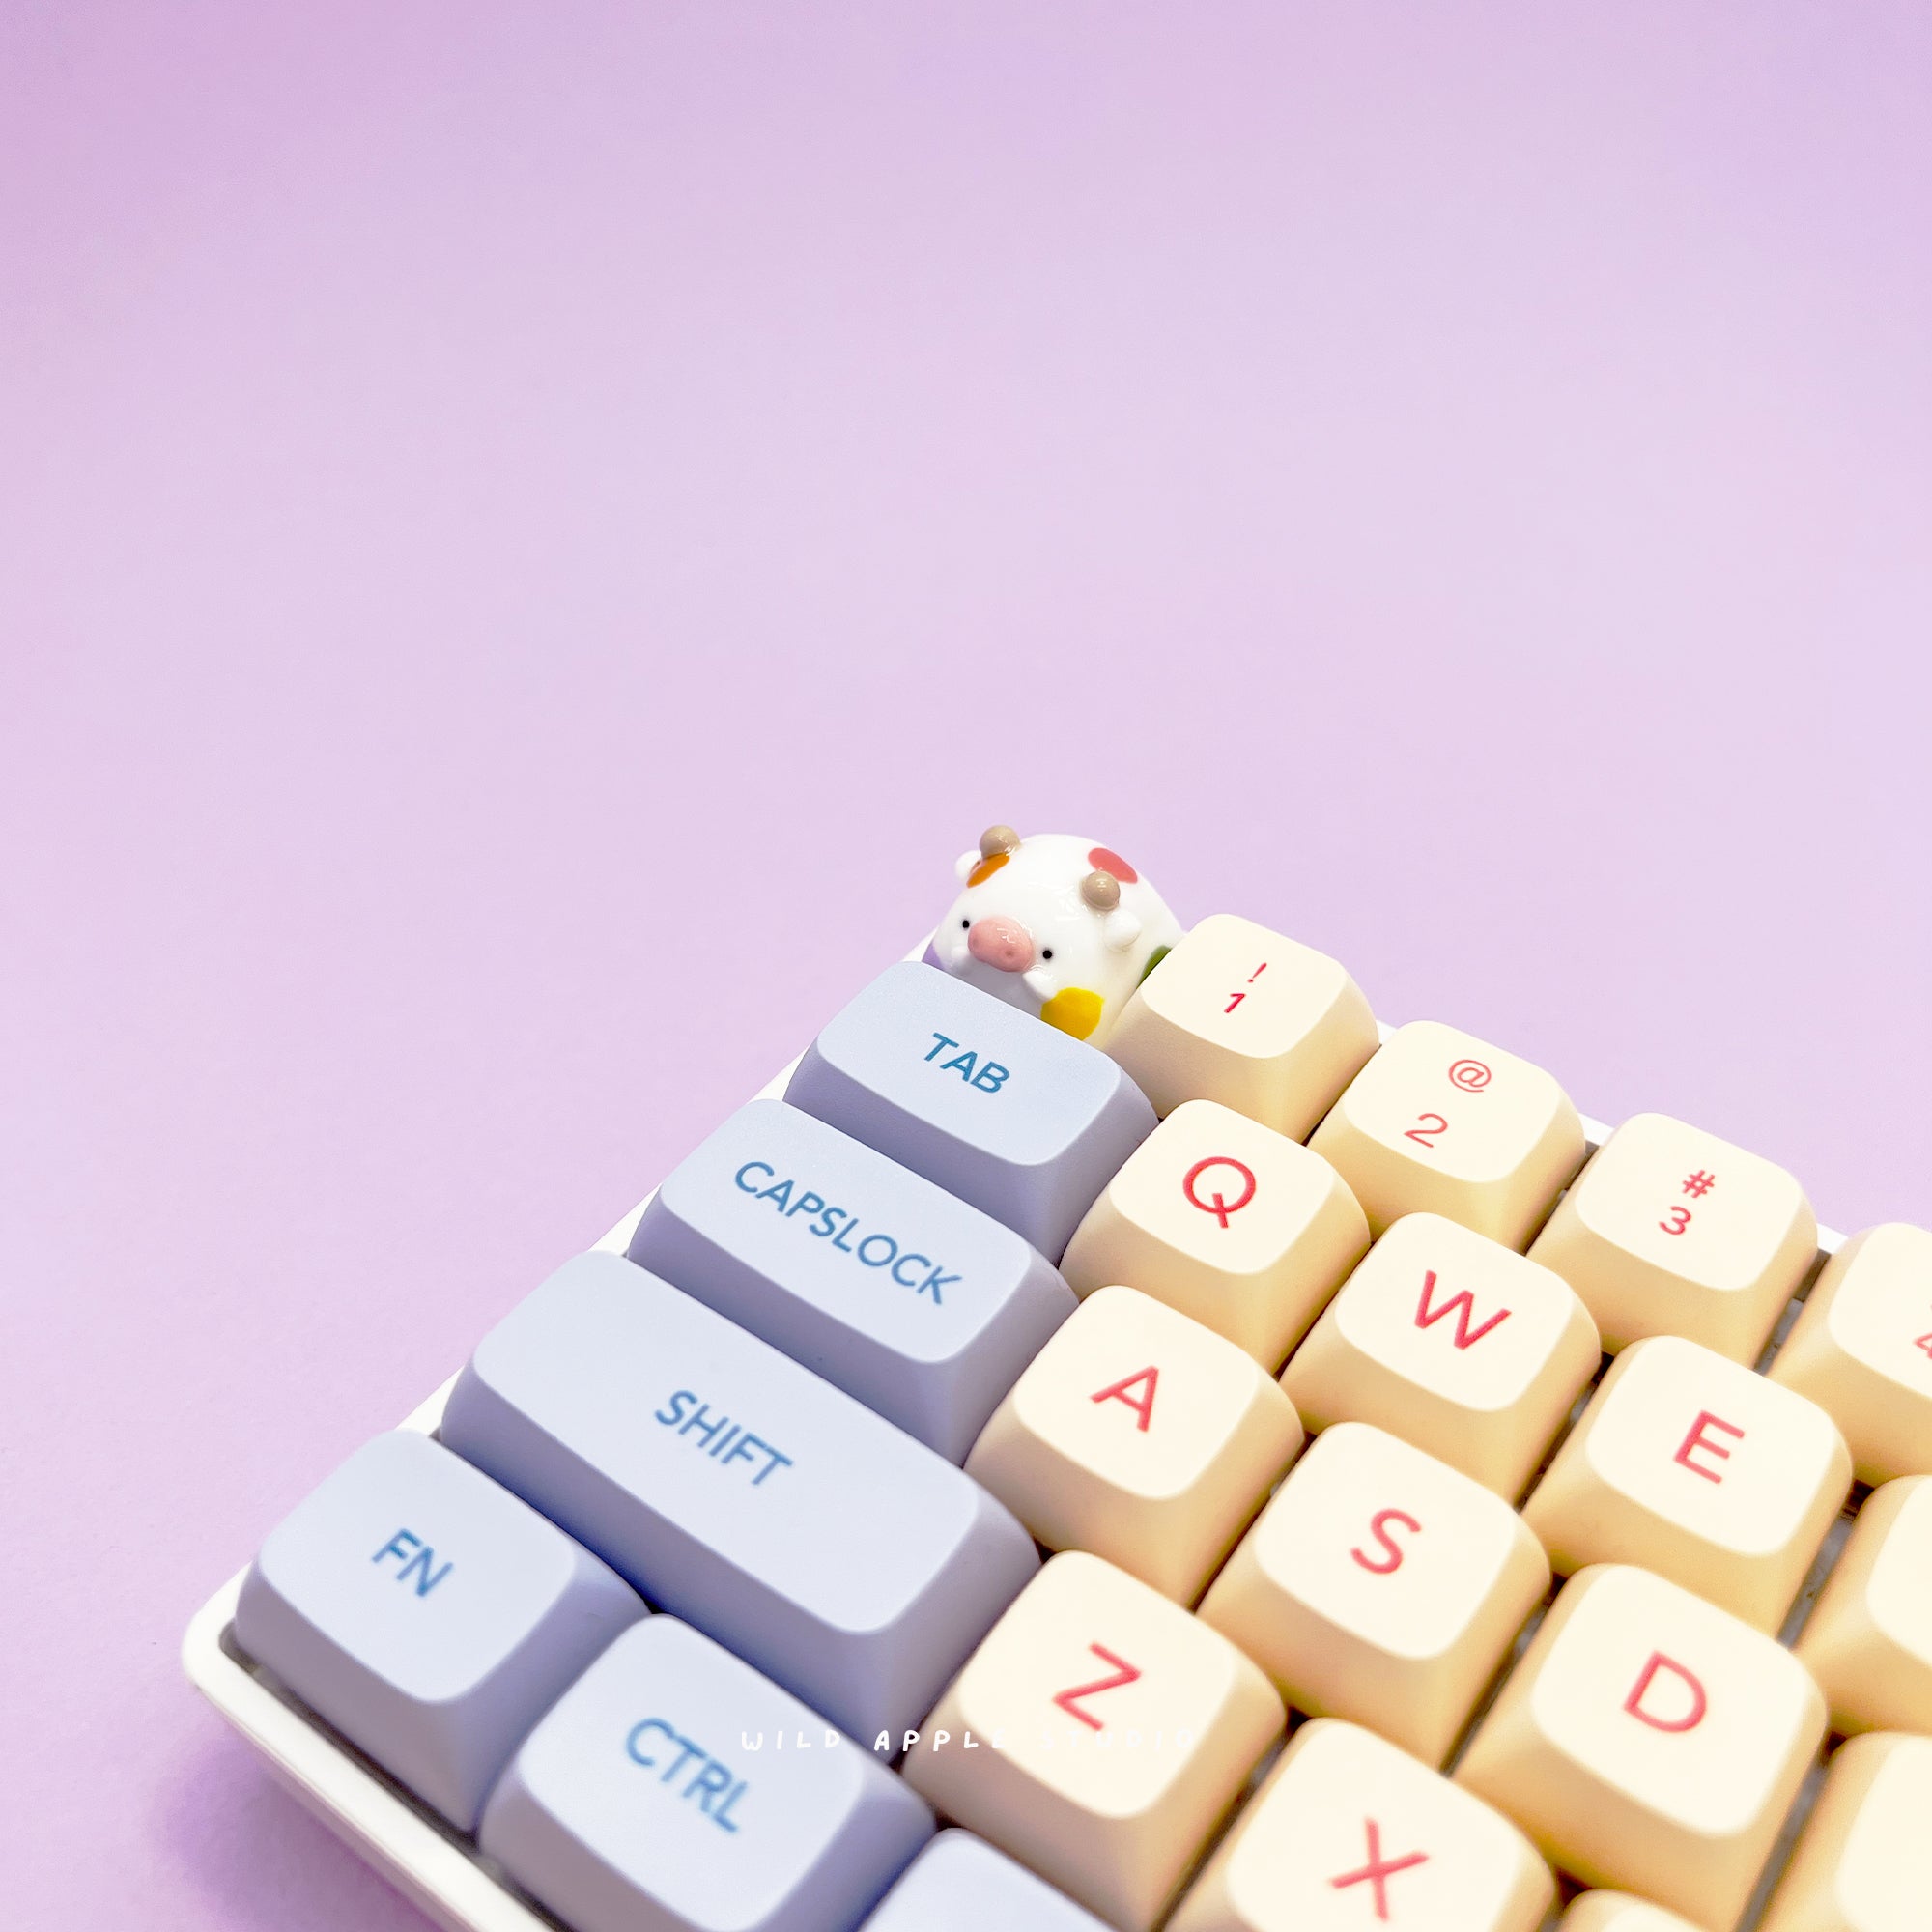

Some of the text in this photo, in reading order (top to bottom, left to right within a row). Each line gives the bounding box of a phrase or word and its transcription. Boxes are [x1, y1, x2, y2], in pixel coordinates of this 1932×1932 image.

[1223, 992, 1246, 1014] 1
[1247, 962, 1267, 983] !
[923, 1032, 1010, 1094] TAB
[1448, 1059, 1492, 1094] @
[1404, 1112, 1448, 1149] 2
[1181, 1155, 1257, 1230] Q
[1658, 1205, 1692, 1236] 3
[1682, 1169, 1716, 1199] #
[734, 1160, 962, 1306] CAPSLOCK
[1413, 1269, 1513, 1351] W
[1090, 1365, 1160, 1433] A
[653, 1389, 795, 1486] SHIFT
[1673, 1410, 1746, 1485] E
[370, 1526, 455, 1599] FN
[1350, 1508, 1423, 1576] S
[1052, 1641, 1143, 1732] Z
[1623, 1650, 1708, 1734] D
[625, 1716, 749, 1834] CTRL
[1327, 1818, 1430, 1922] X
